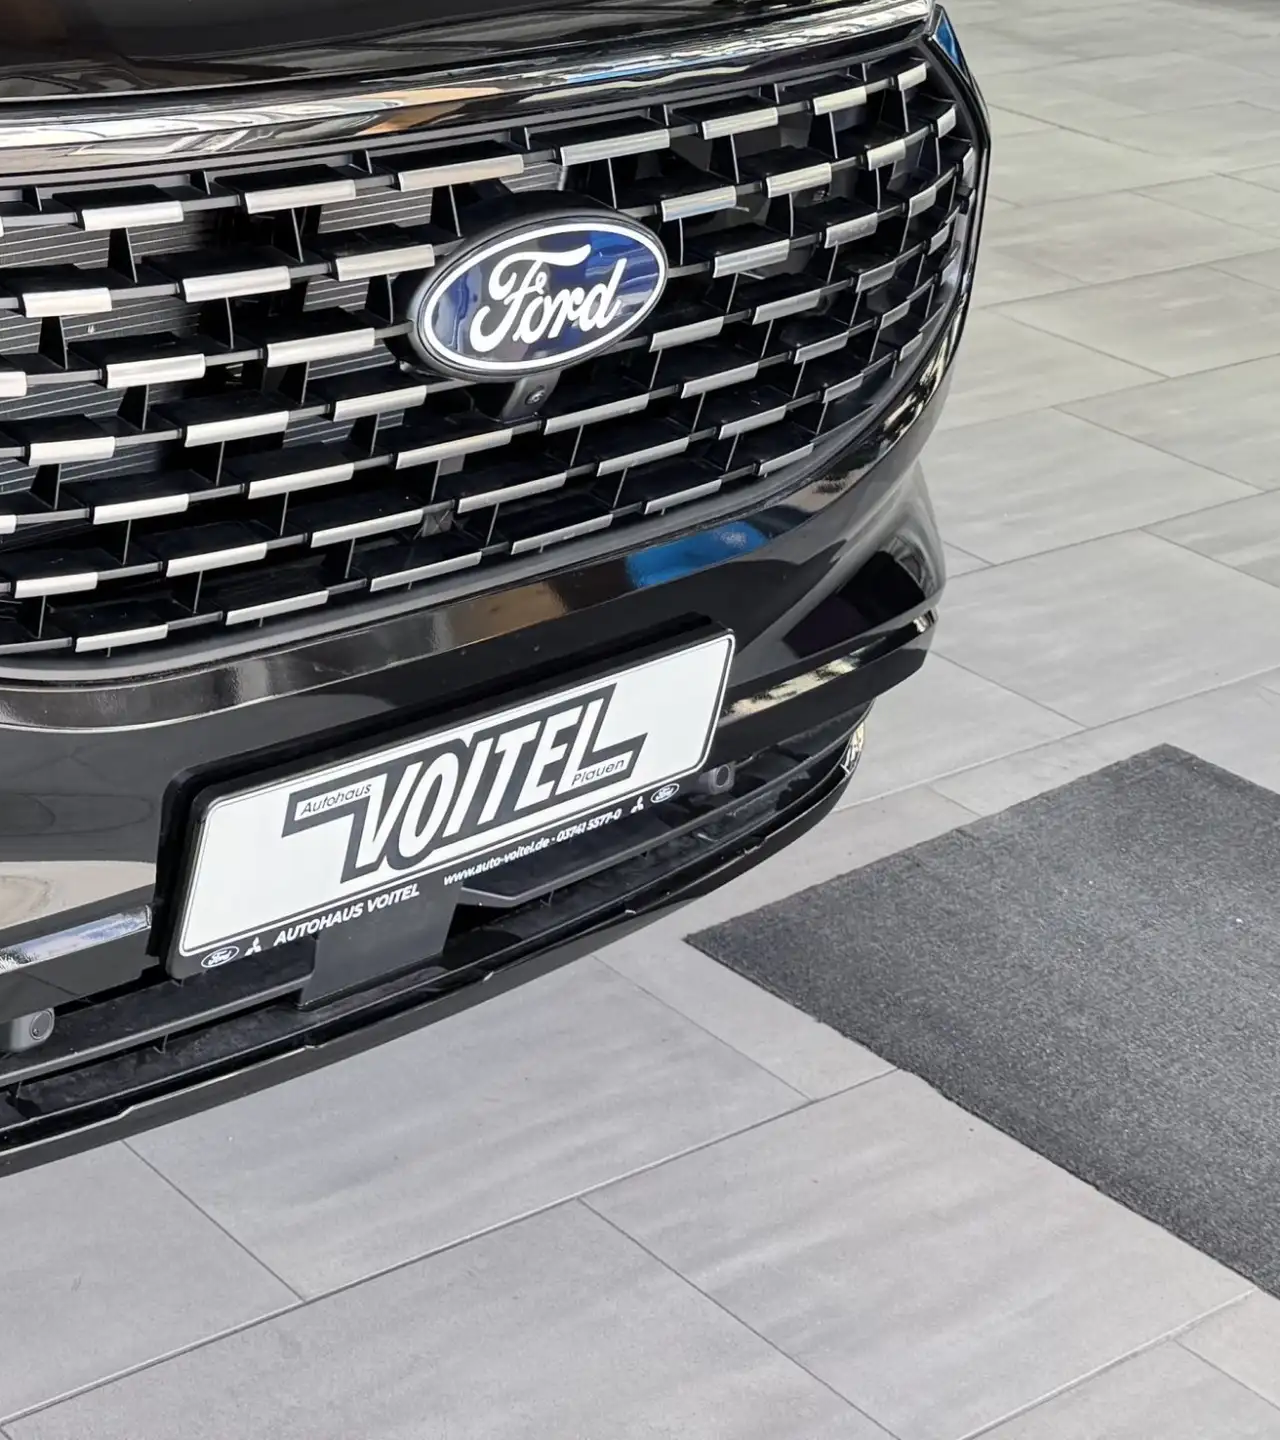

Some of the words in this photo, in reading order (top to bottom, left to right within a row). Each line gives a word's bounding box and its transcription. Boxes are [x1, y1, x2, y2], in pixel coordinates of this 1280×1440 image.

[465, 240, 631, 356] Ford
[299, 782, 372, 817] Autohaus
[354, 697, 620, 869] VOITEL
[570, 756, 626, 788] Plauen
[273, 902, 365, 947] AUTOHAUS
[366, 882, 421, 914] VOITEL
[443, 836, 550, 886] www.auto-voitel.de
[585, 807, 623, 832] 5577-0
